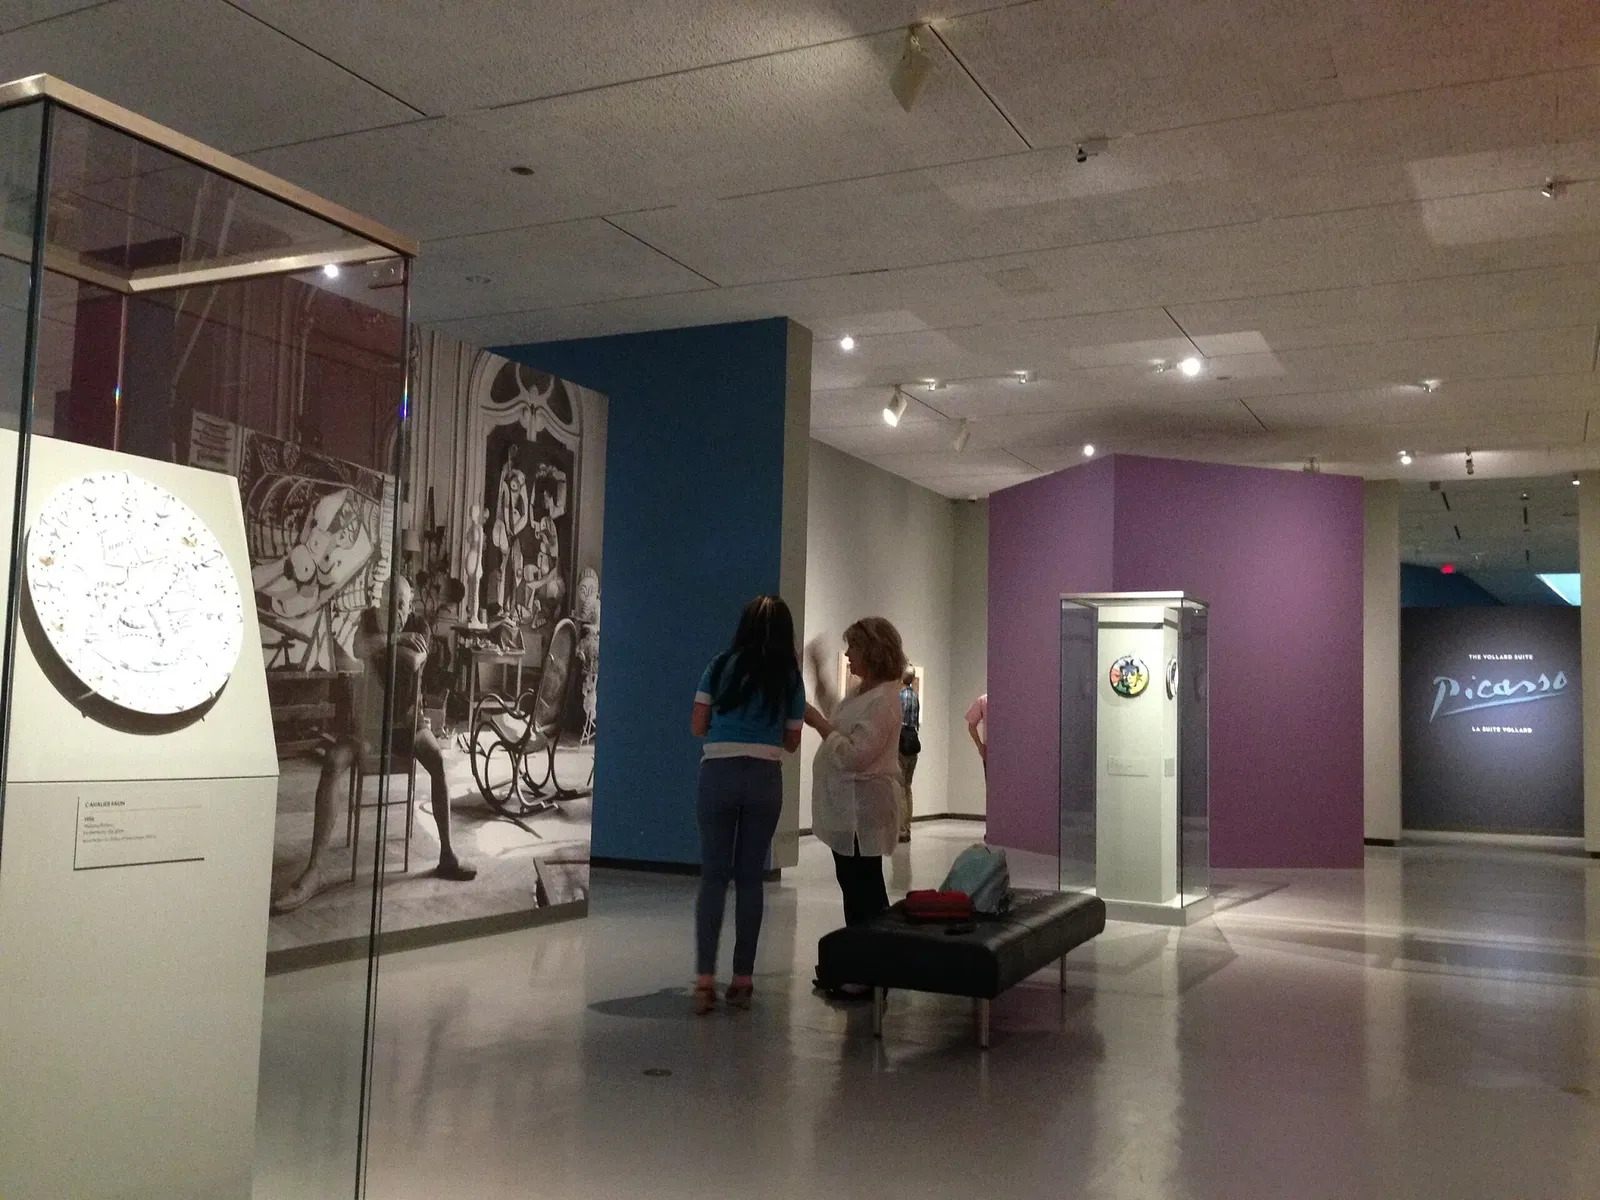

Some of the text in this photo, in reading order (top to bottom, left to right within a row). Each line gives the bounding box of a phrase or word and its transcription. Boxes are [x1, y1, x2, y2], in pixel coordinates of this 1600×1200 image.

[1468, 653, 1534, 661] THE VOLLARD SUITE
[1429, 670, 1568, 723] Picasso
[1502, 726, 1533, 734] VOLLARD
